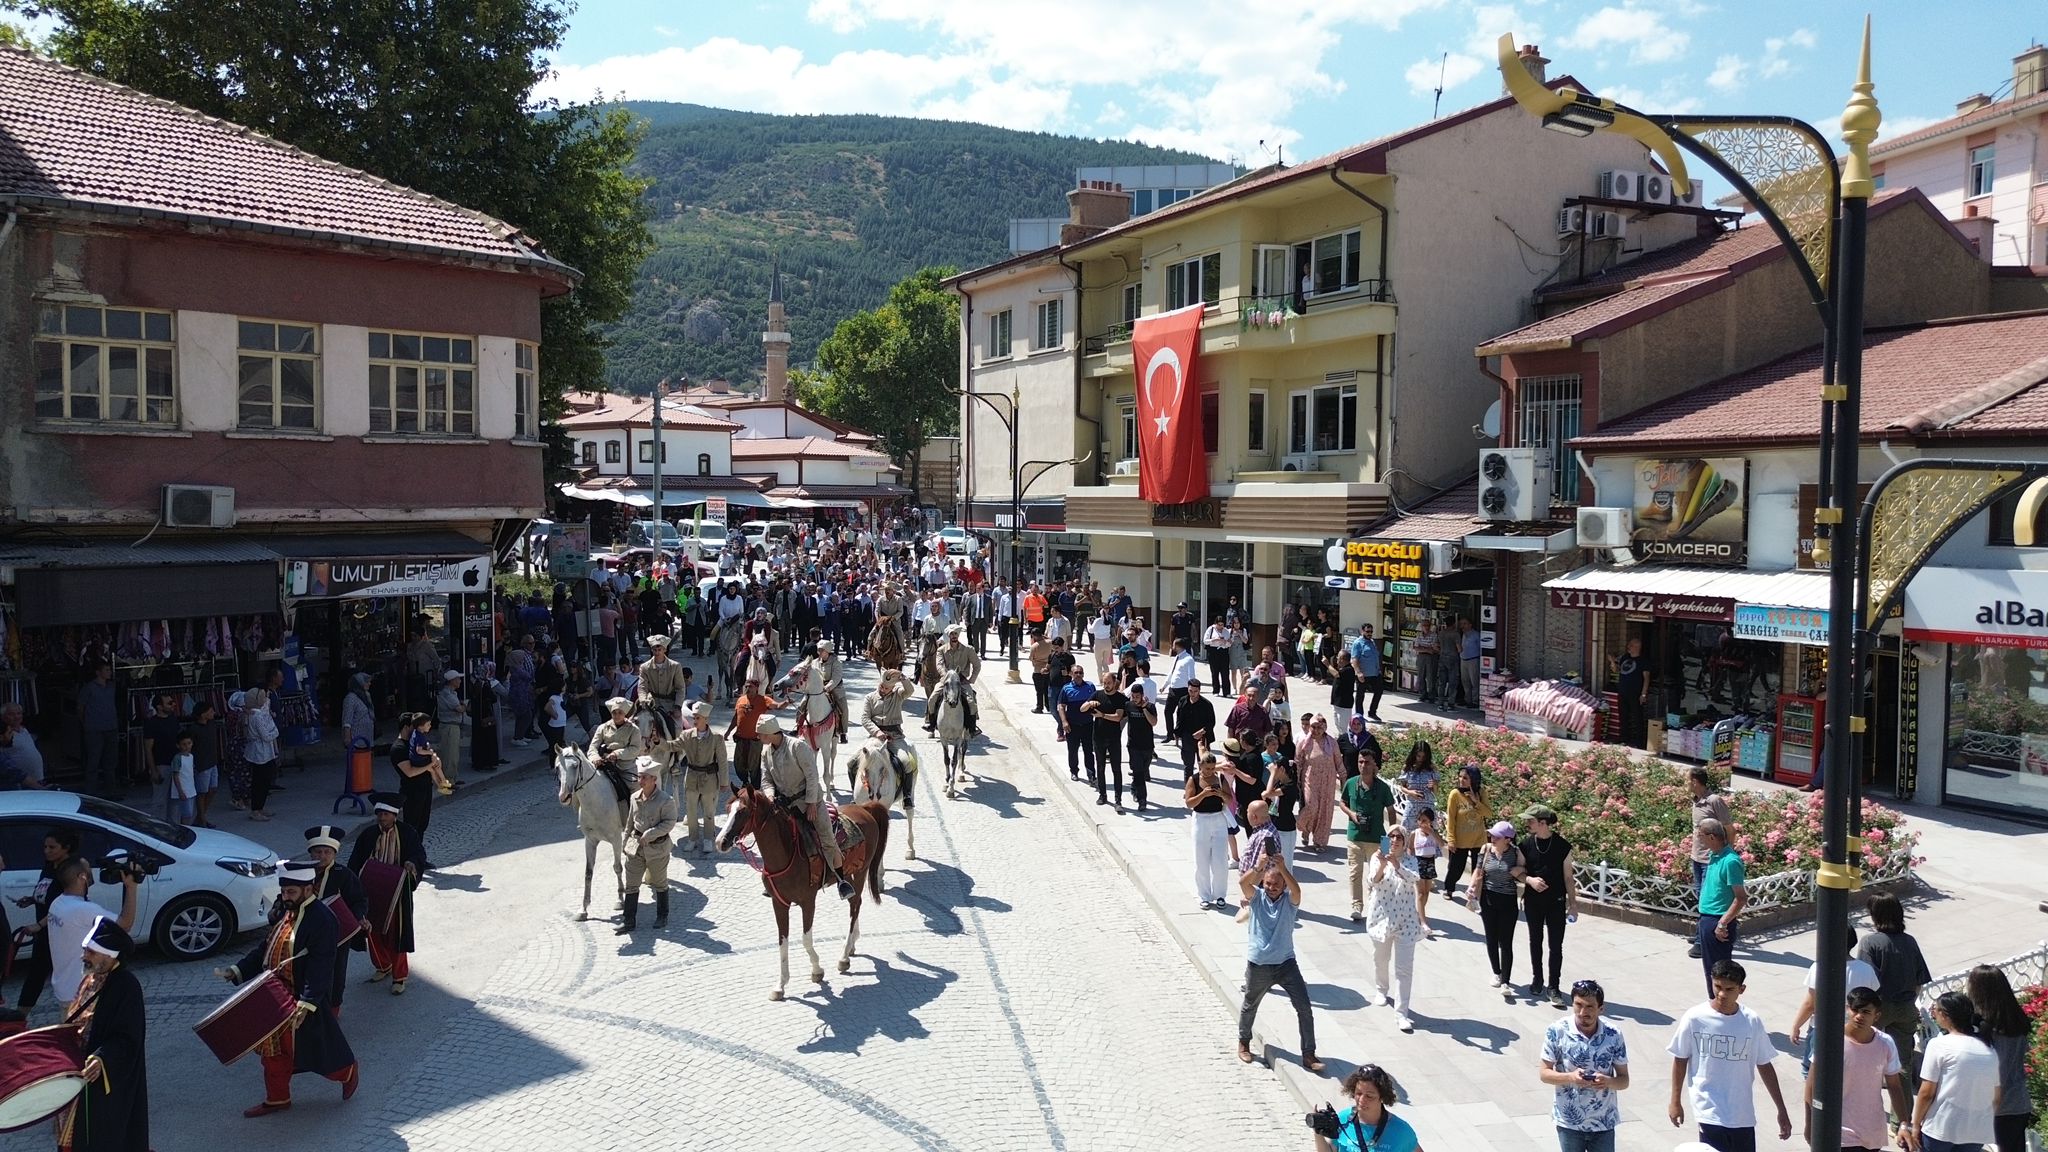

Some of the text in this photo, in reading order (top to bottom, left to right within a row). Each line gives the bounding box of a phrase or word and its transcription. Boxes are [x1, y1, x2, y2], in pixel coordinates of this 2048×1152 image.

[1346, 541, 1423, 560] BOZOĞLU
[1642, 542, 1731, 556] KOMCERO
[331, 560, 460, 585] UMUT İLETİŞİM
[1346, 558, 1421, 581] İLETİŞİM
[365, 586, 435, 595] TEKNİK SERVİS
[1556, 590, 1725, 614] YILDIZ Ayakkabı
[1975, 600, 2048, 628] alBa
[1736, 623, 1779, 638] NARGİLE
[1974, 636, 2020, 646] ALBARAKA
[1909, 656, 1917, 703] ÜTÜN
[1718, 732, 1730, 744] EFE
